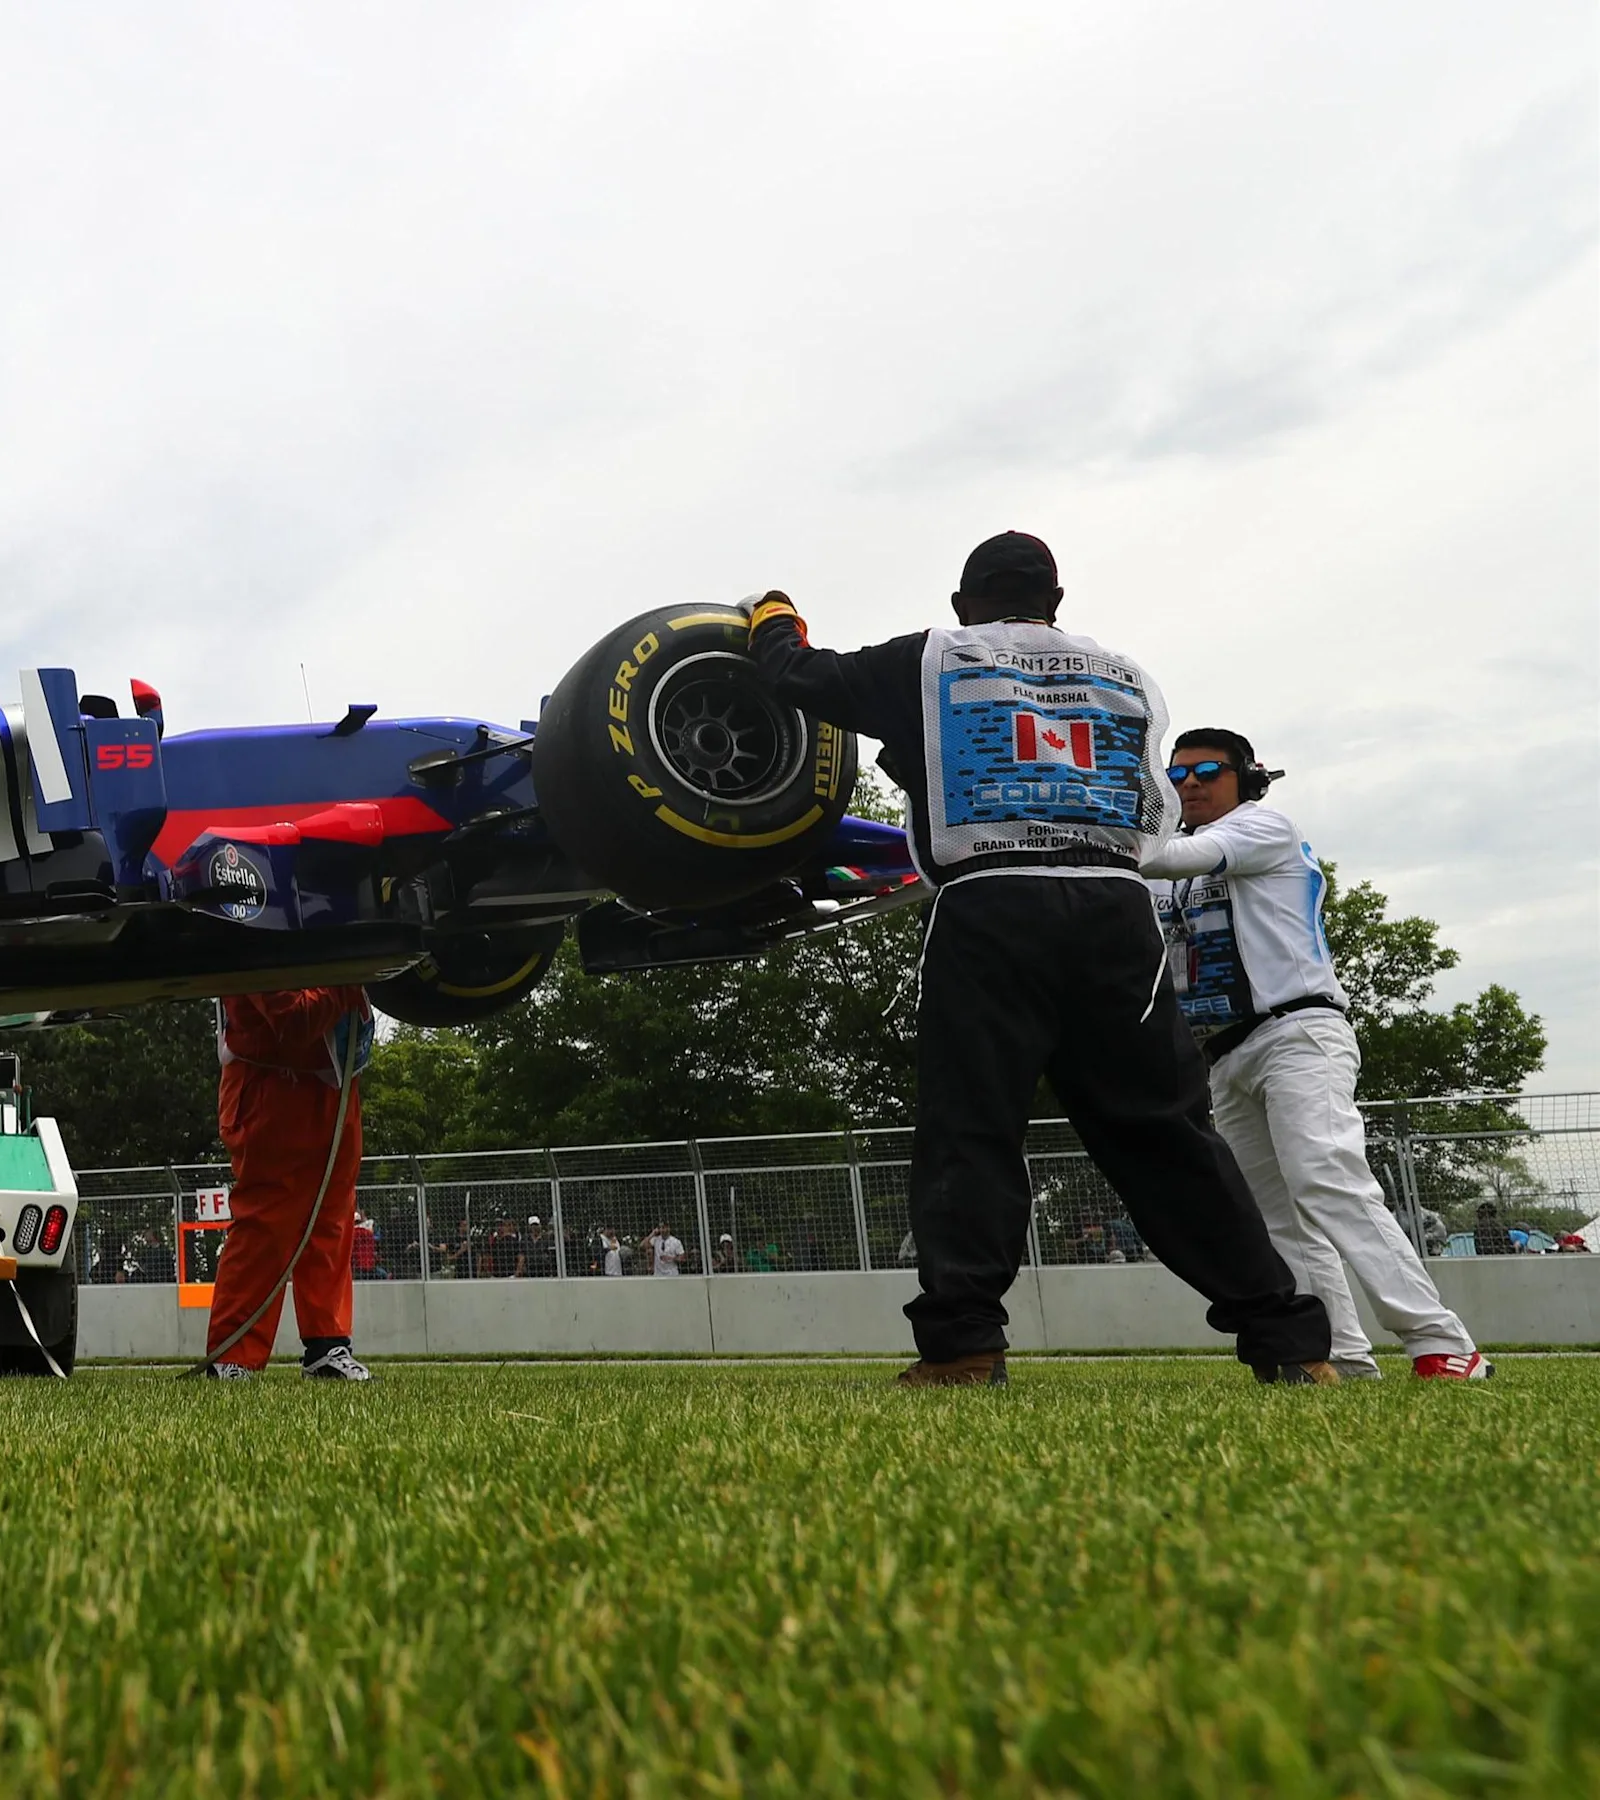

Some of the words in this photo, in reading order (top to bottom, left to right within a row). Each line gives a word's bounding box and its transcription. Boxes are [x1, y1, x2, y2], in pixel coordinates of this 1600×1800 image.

[607, 631, 660, 757] ZERO
[1036, 692, 1090, 704] MARSHAL
[96, 744, 154, 770] 55
[814, 720, 843, 801] RELLI
[971, 781, 1140, 816] COURSE
[973, 840, 1015, 853] GRAND
[1018, 837, 1047, 849] PRIX
[214, 861, 257, 888] Estrella
